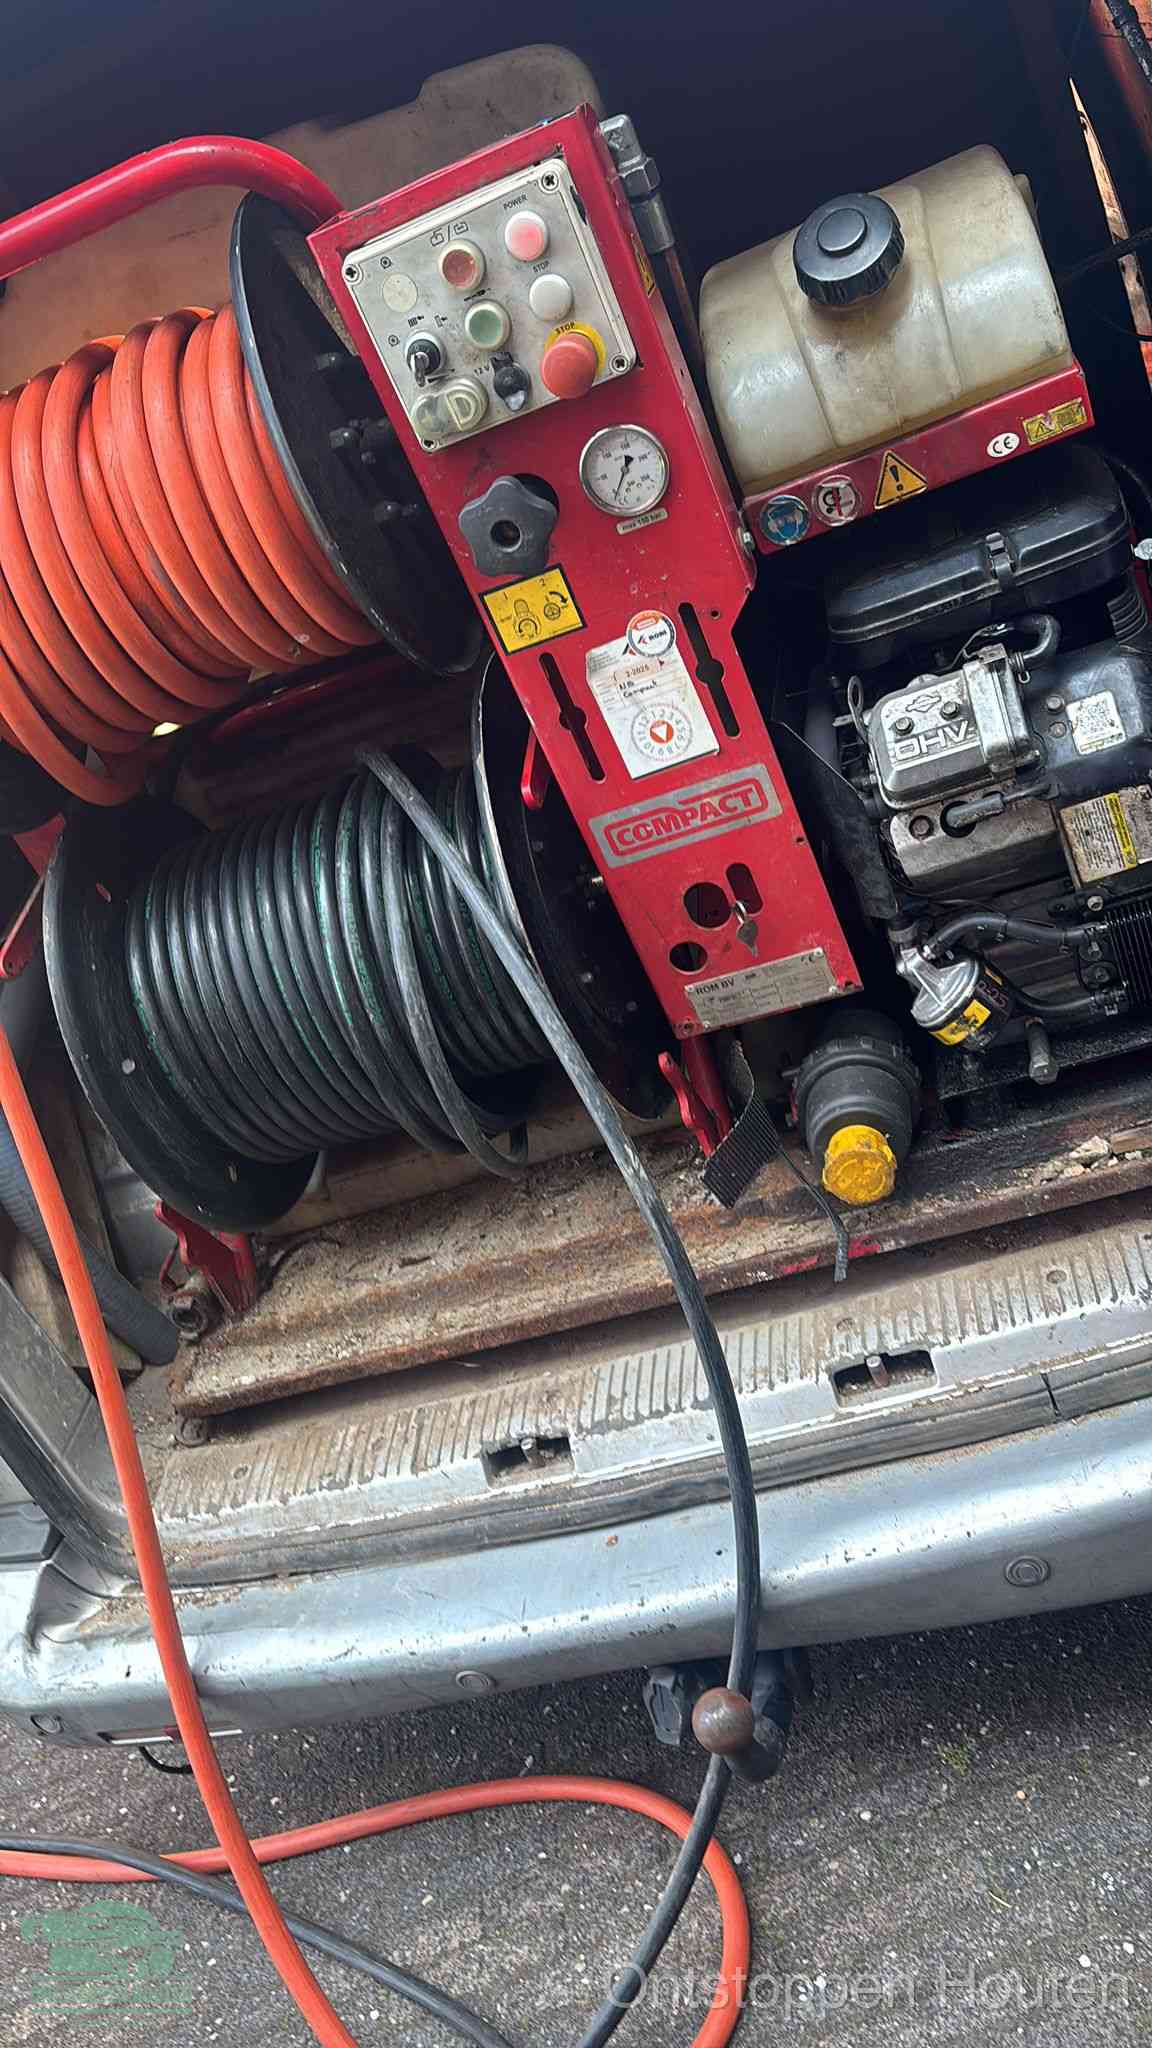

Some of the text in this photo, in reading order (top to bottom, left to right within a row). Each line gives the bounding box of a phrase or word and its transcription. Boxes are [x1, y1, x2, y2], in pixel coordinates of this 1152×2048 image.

[503, 195, 528, 210] POWER
[533, 261, 549, 273] STOP
[555, 323, 575, 334] STOP
[992, 435, 1013, 454] CE
[616, 787, 753, 846] COMPACT
